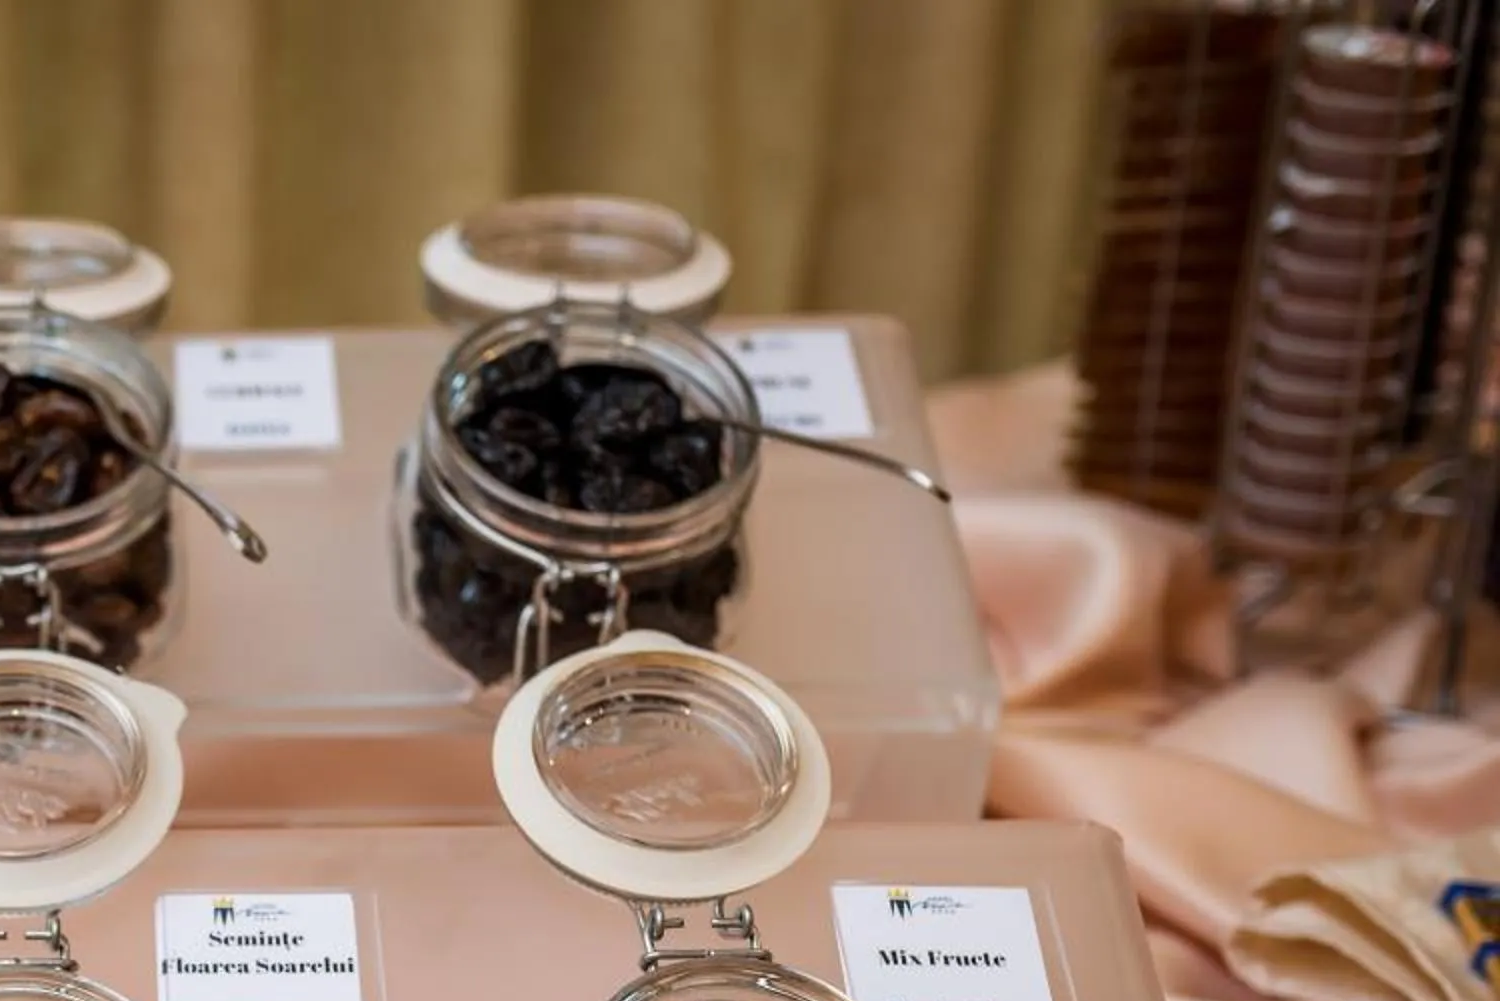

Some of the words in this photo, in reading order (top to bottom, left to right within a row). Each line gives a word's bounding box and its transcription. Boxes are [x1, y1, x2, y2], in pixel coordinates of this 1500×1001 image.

[161, 957, 249, 975] Floarea
[255, 957, 355, 974] Soarelui
[878, 949, 922, 966] Mix
[927, 950, 1007, 968] Fructe
